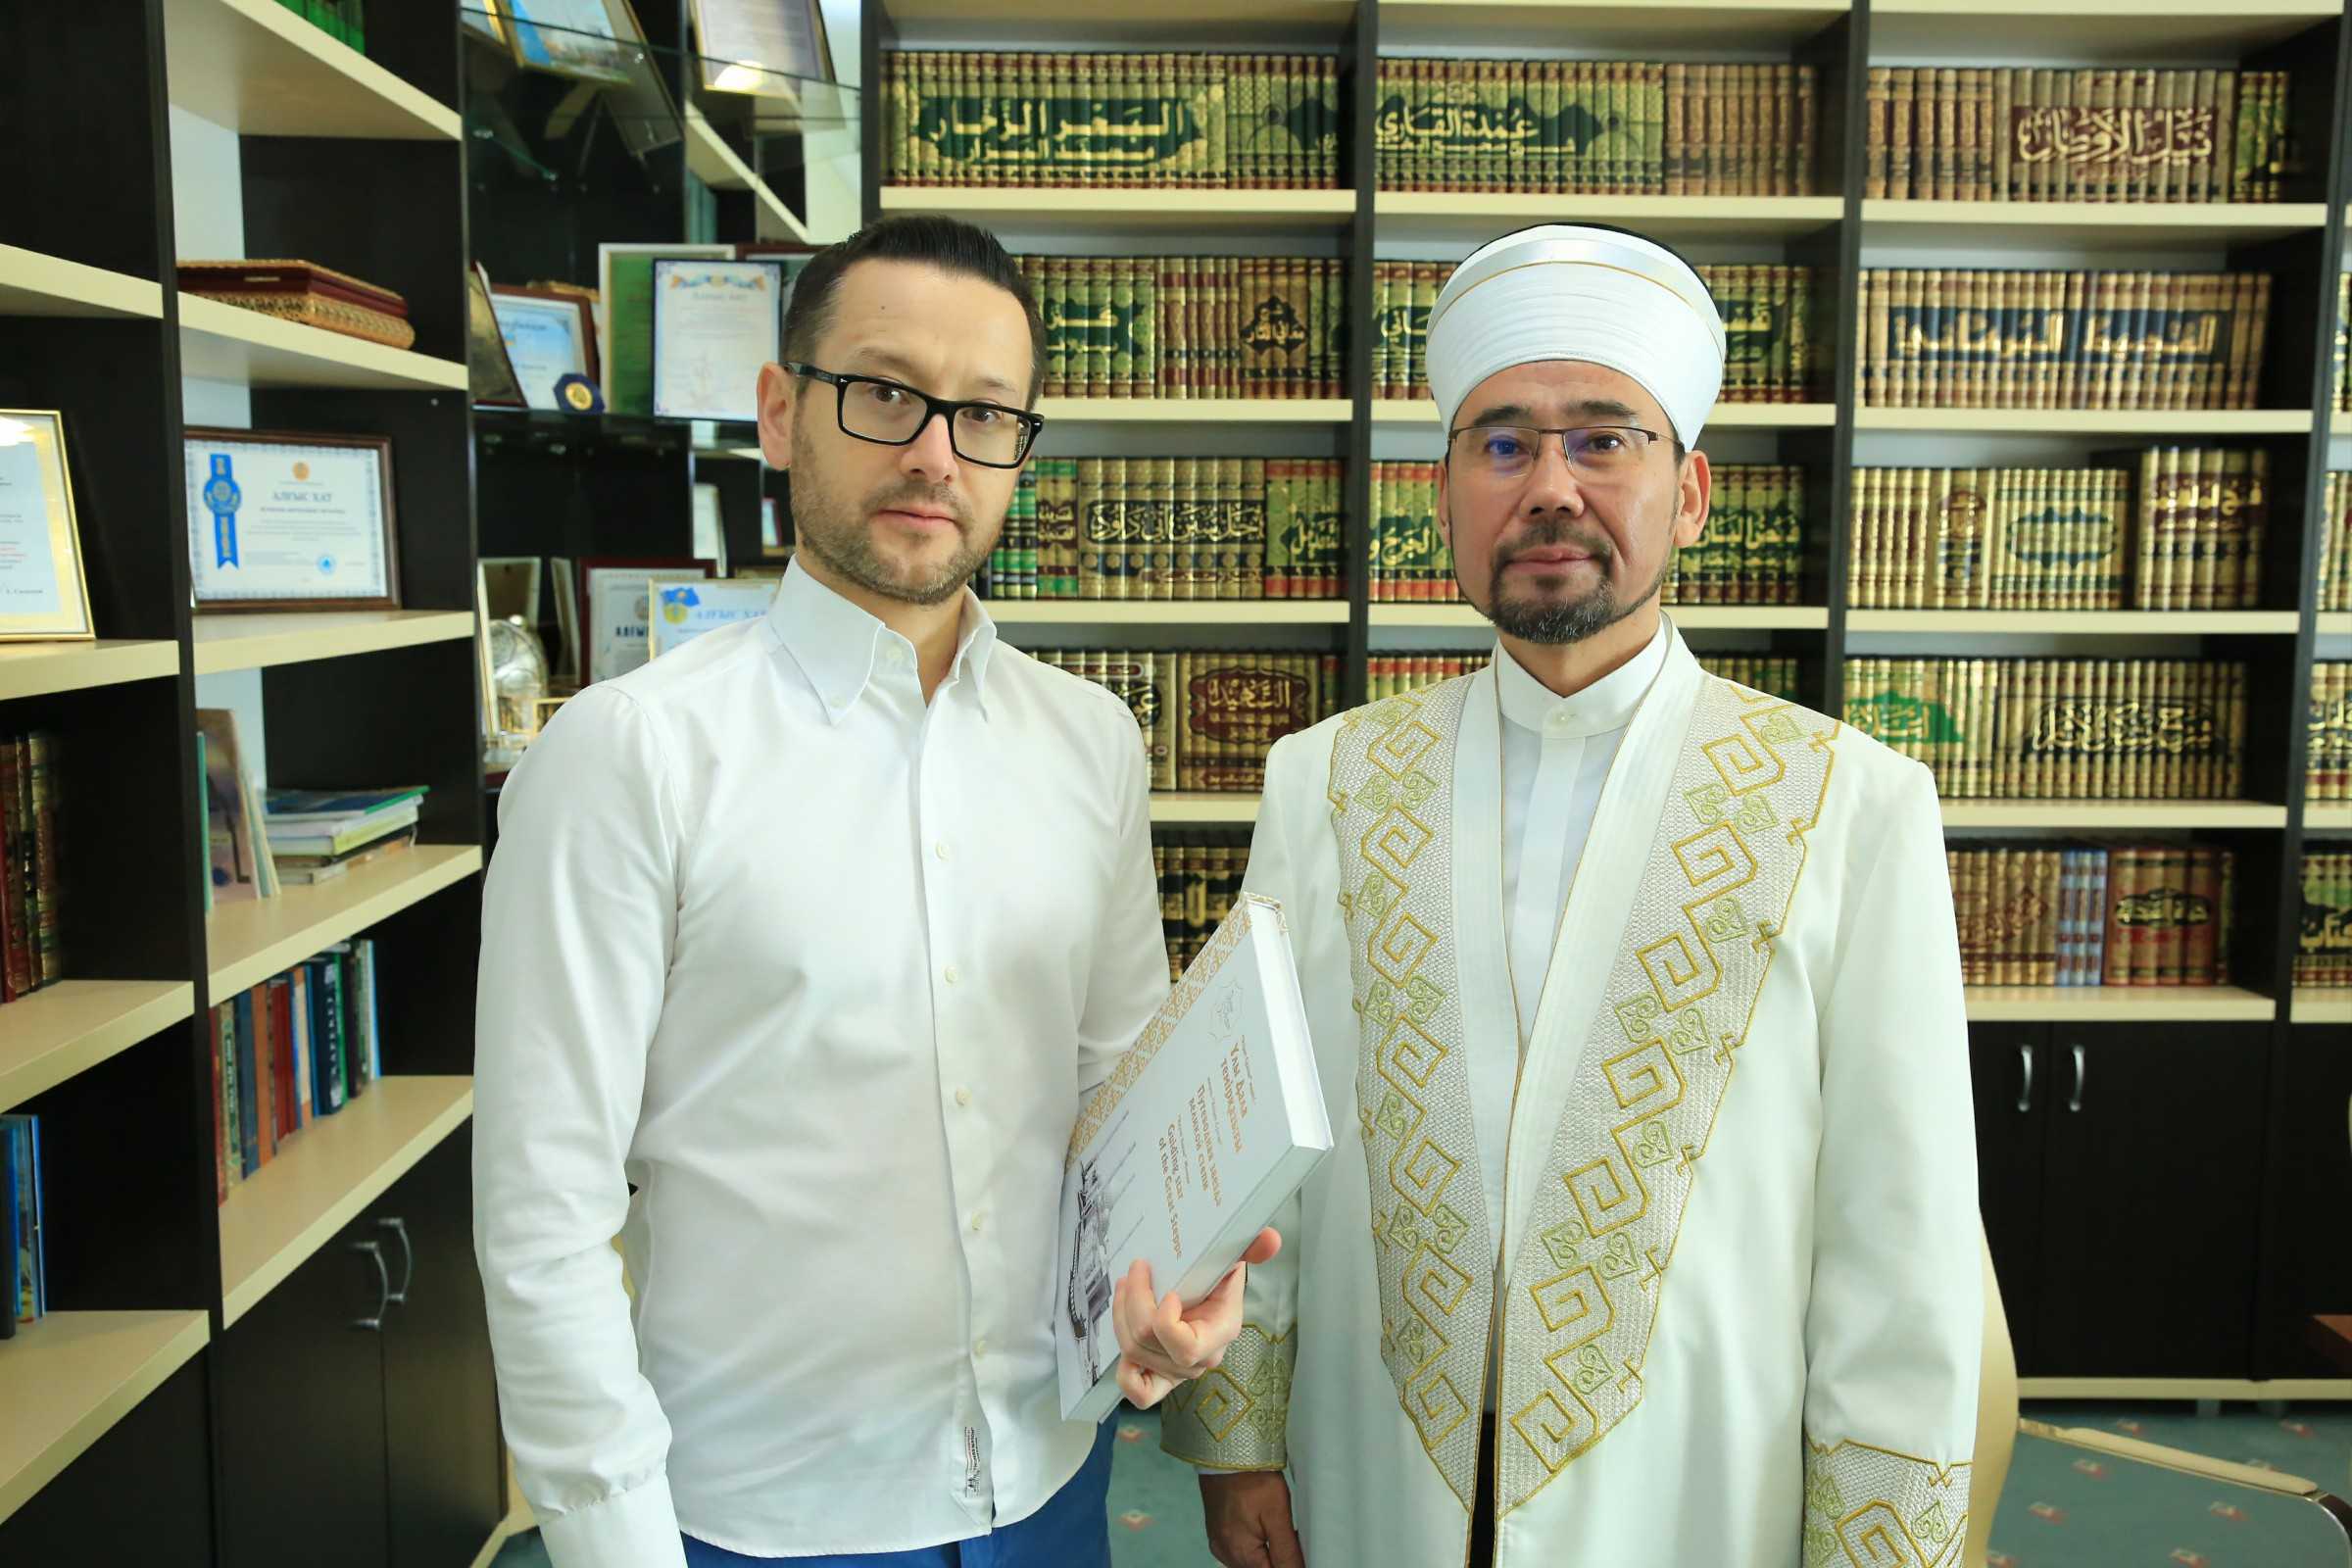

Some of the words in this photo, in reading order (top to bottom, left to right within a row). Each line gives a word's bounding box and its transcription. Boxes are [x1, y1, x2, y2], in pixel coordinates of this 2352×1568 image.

[1158, 1137, 1167, 1152] of
[1160, 1152, 1169, 1176] the
[1167, 1123, 1180, 1175] Guiding
[1175, 1175, 1184, 1200] star
[1189, 1098, 1202, 1152] великой
[1198, 1152, 1209, 1192] степи
[1197, 1082, 1214, 1161] Путеводная
[1210, 1162, 1222, 1207] звезда
[1164, 1176, 1175, 1212] Great
[1169, 1212, 1182, 1262] Steppe
